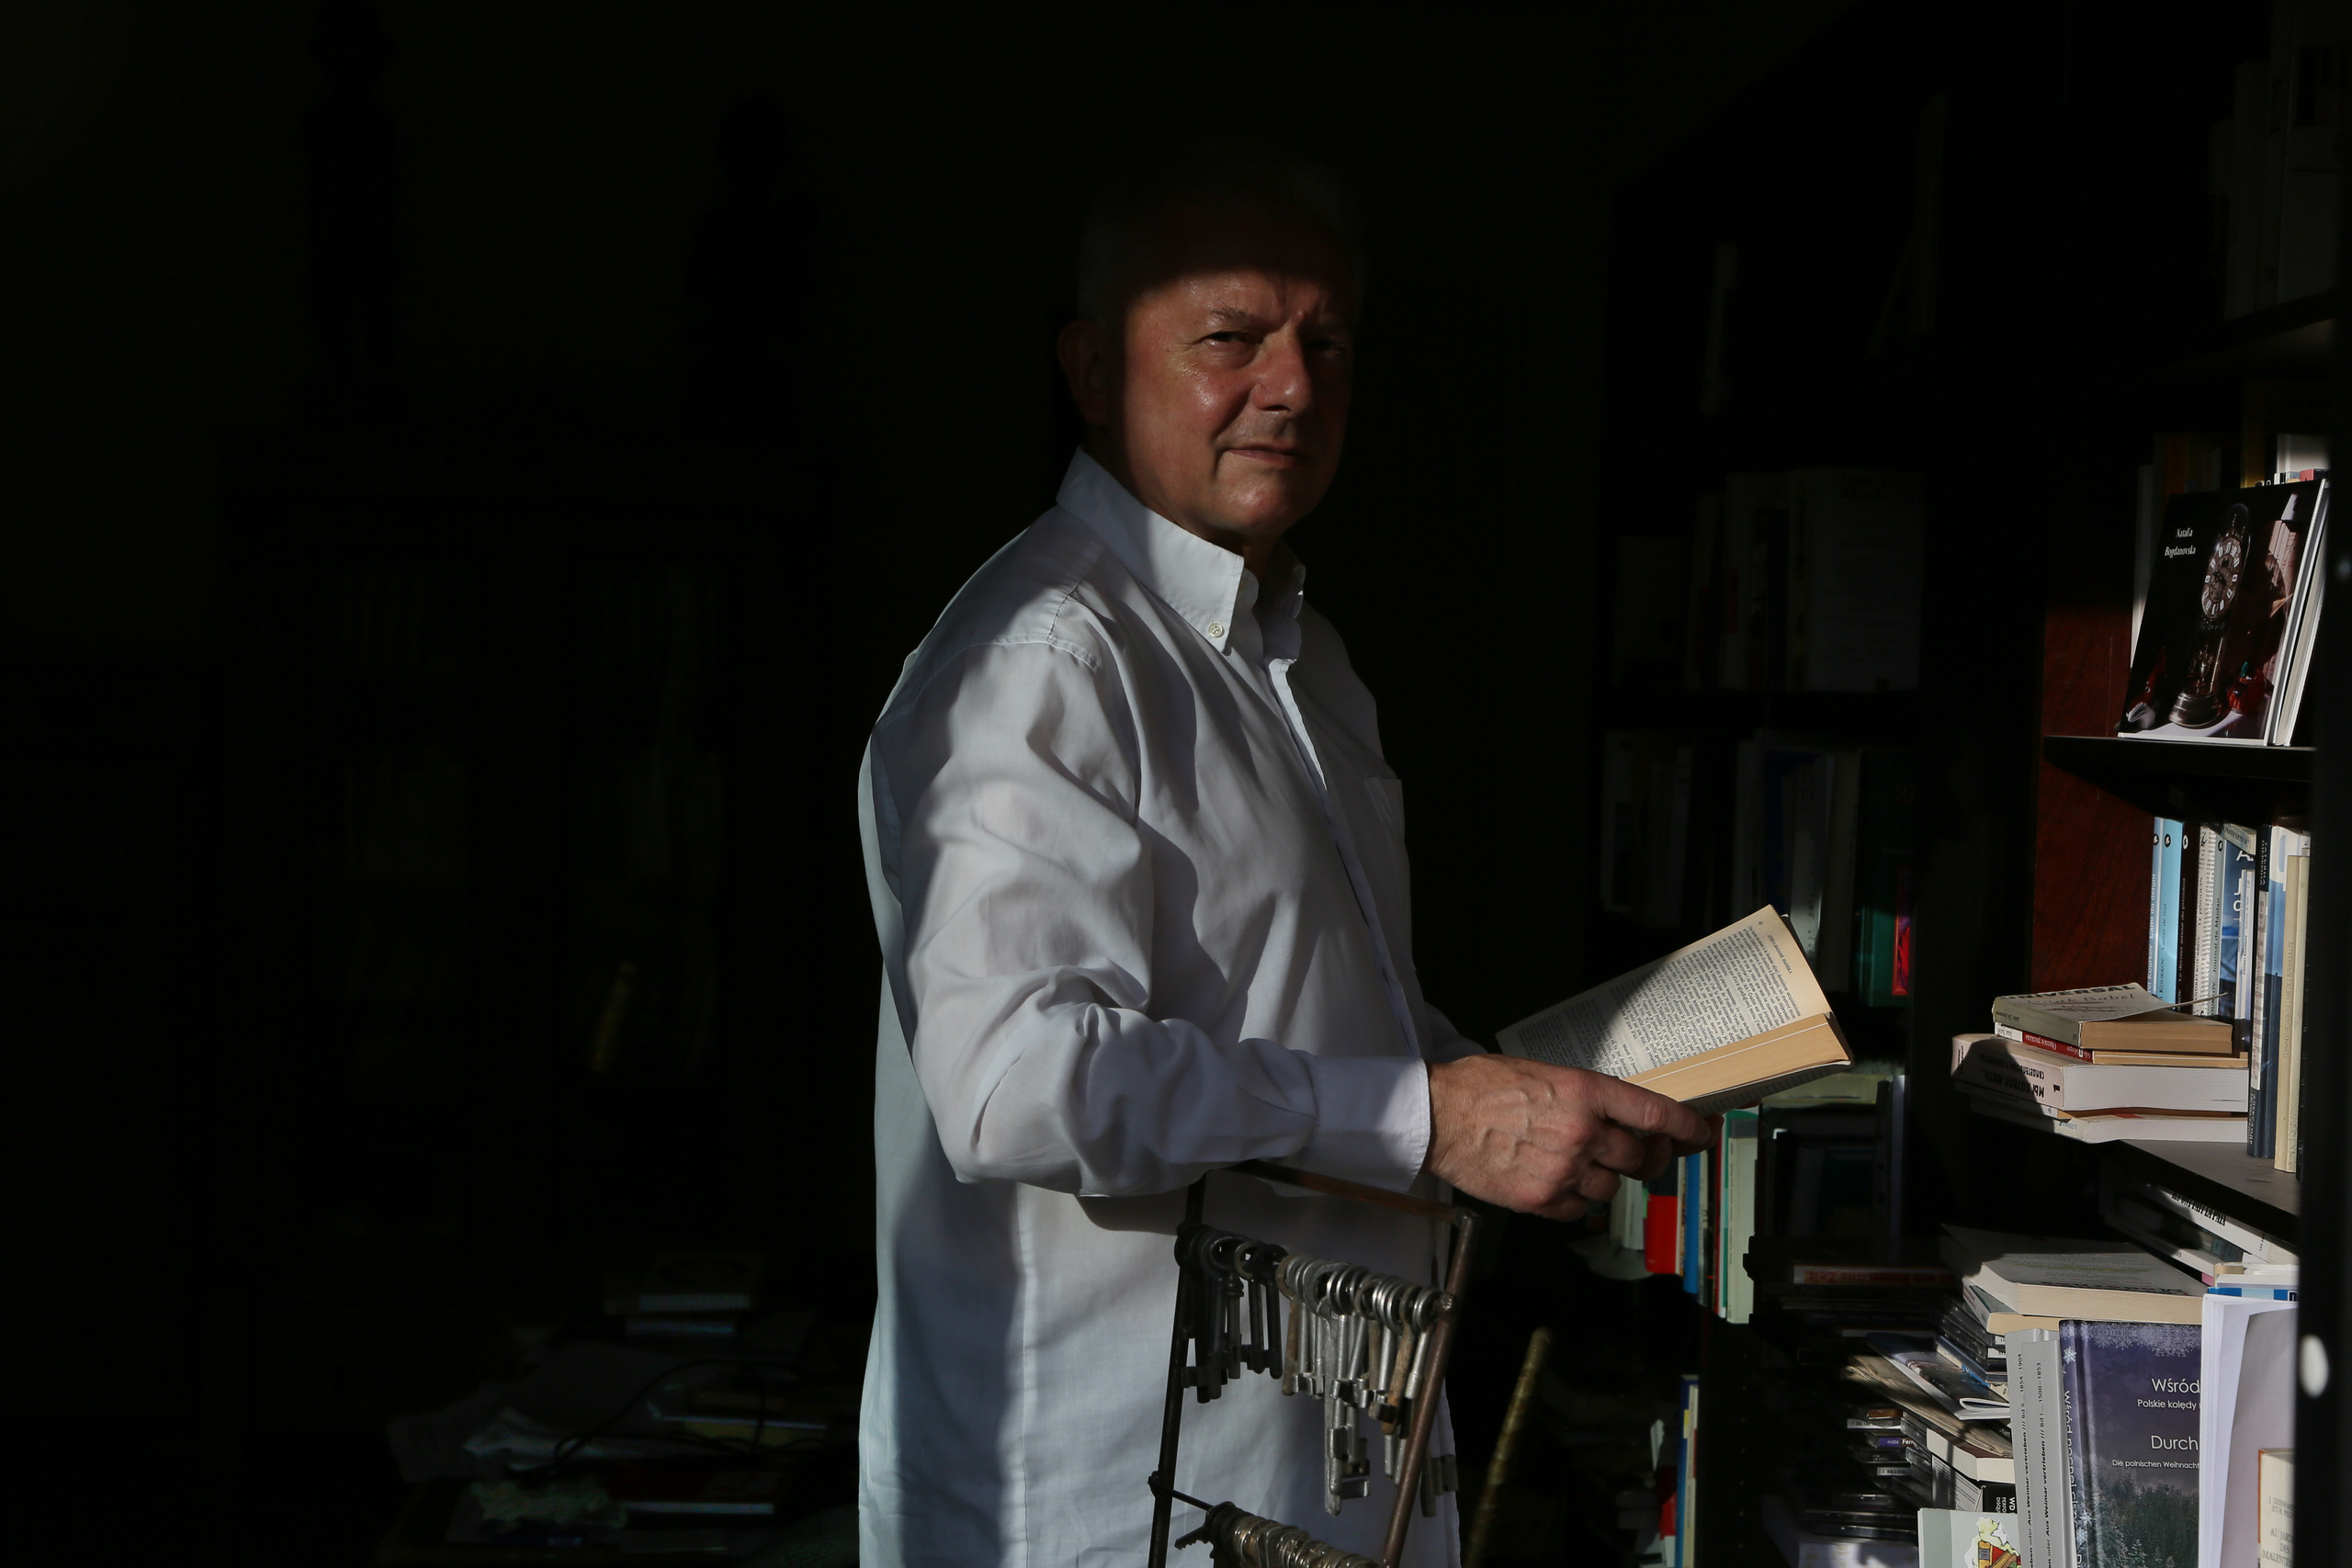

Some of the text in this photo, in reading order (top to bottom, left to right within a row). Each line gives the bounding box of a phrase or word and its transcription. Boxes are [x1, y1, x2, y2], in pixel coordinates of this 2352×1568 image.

[2175, 527, 2193, 537] Natalia
[2149, 903, 2154, 913] du
[2162, 918, 2166, 926] de
[2213, 930, 2218, 940] de
[2177, 973, 2181, 981] Le
[2180, 910, 2184, 920] du
[1776, 973, 1789, 991] dernières
[1692, 998, 1703, 1015] hommes
[1753, 991, 1766, 1010] vraiment
[1781, 994, 1791, 1009] mettre
[1788, 1009, 1796, 1019] mon
[1707, 1004, 1719, 1021] pendant
[1721, 1005, 1734, 1023] existante
[1765, 1002, 1776, 1018] maison
[1773, 1004, 1786, 1024] moderne
[1758, 1011, 1766, 1023] dans
[1710, 1021, 1718, 1034] sauve
[1720, 1016, 1731, 1032] théâtre
[1649, 1029, 1657, 1041] auras
[1622, 1043, 1631, 1055] Mardi
[1660, 1040, 1672, 1056] religion
[2030, 1084, 2046, 1098] МЫ
[1808, 1270, 1837, 1283] Zeit
[1869, 1272, 1908, 1285] Raum
[1914, 1274, 1934, 1283] ein
[2151, 1376, 2199, 1393] Wśród
[2137, 1399, 2197, 1410] Polskie kolędy
[2020, 1409, 2025, 1418] Bd
[2039, 1417, 2043, 1427] Bd
[2150, 1434, 2199, 1450] Durch
[2040, 1440, 2048, 1484] vertrieben
[2125, 1460, 2161, 1469] polnischen
[2007, 1496, 2016, 1511] WD
[2279, 1542, 2290, 1554] DES
